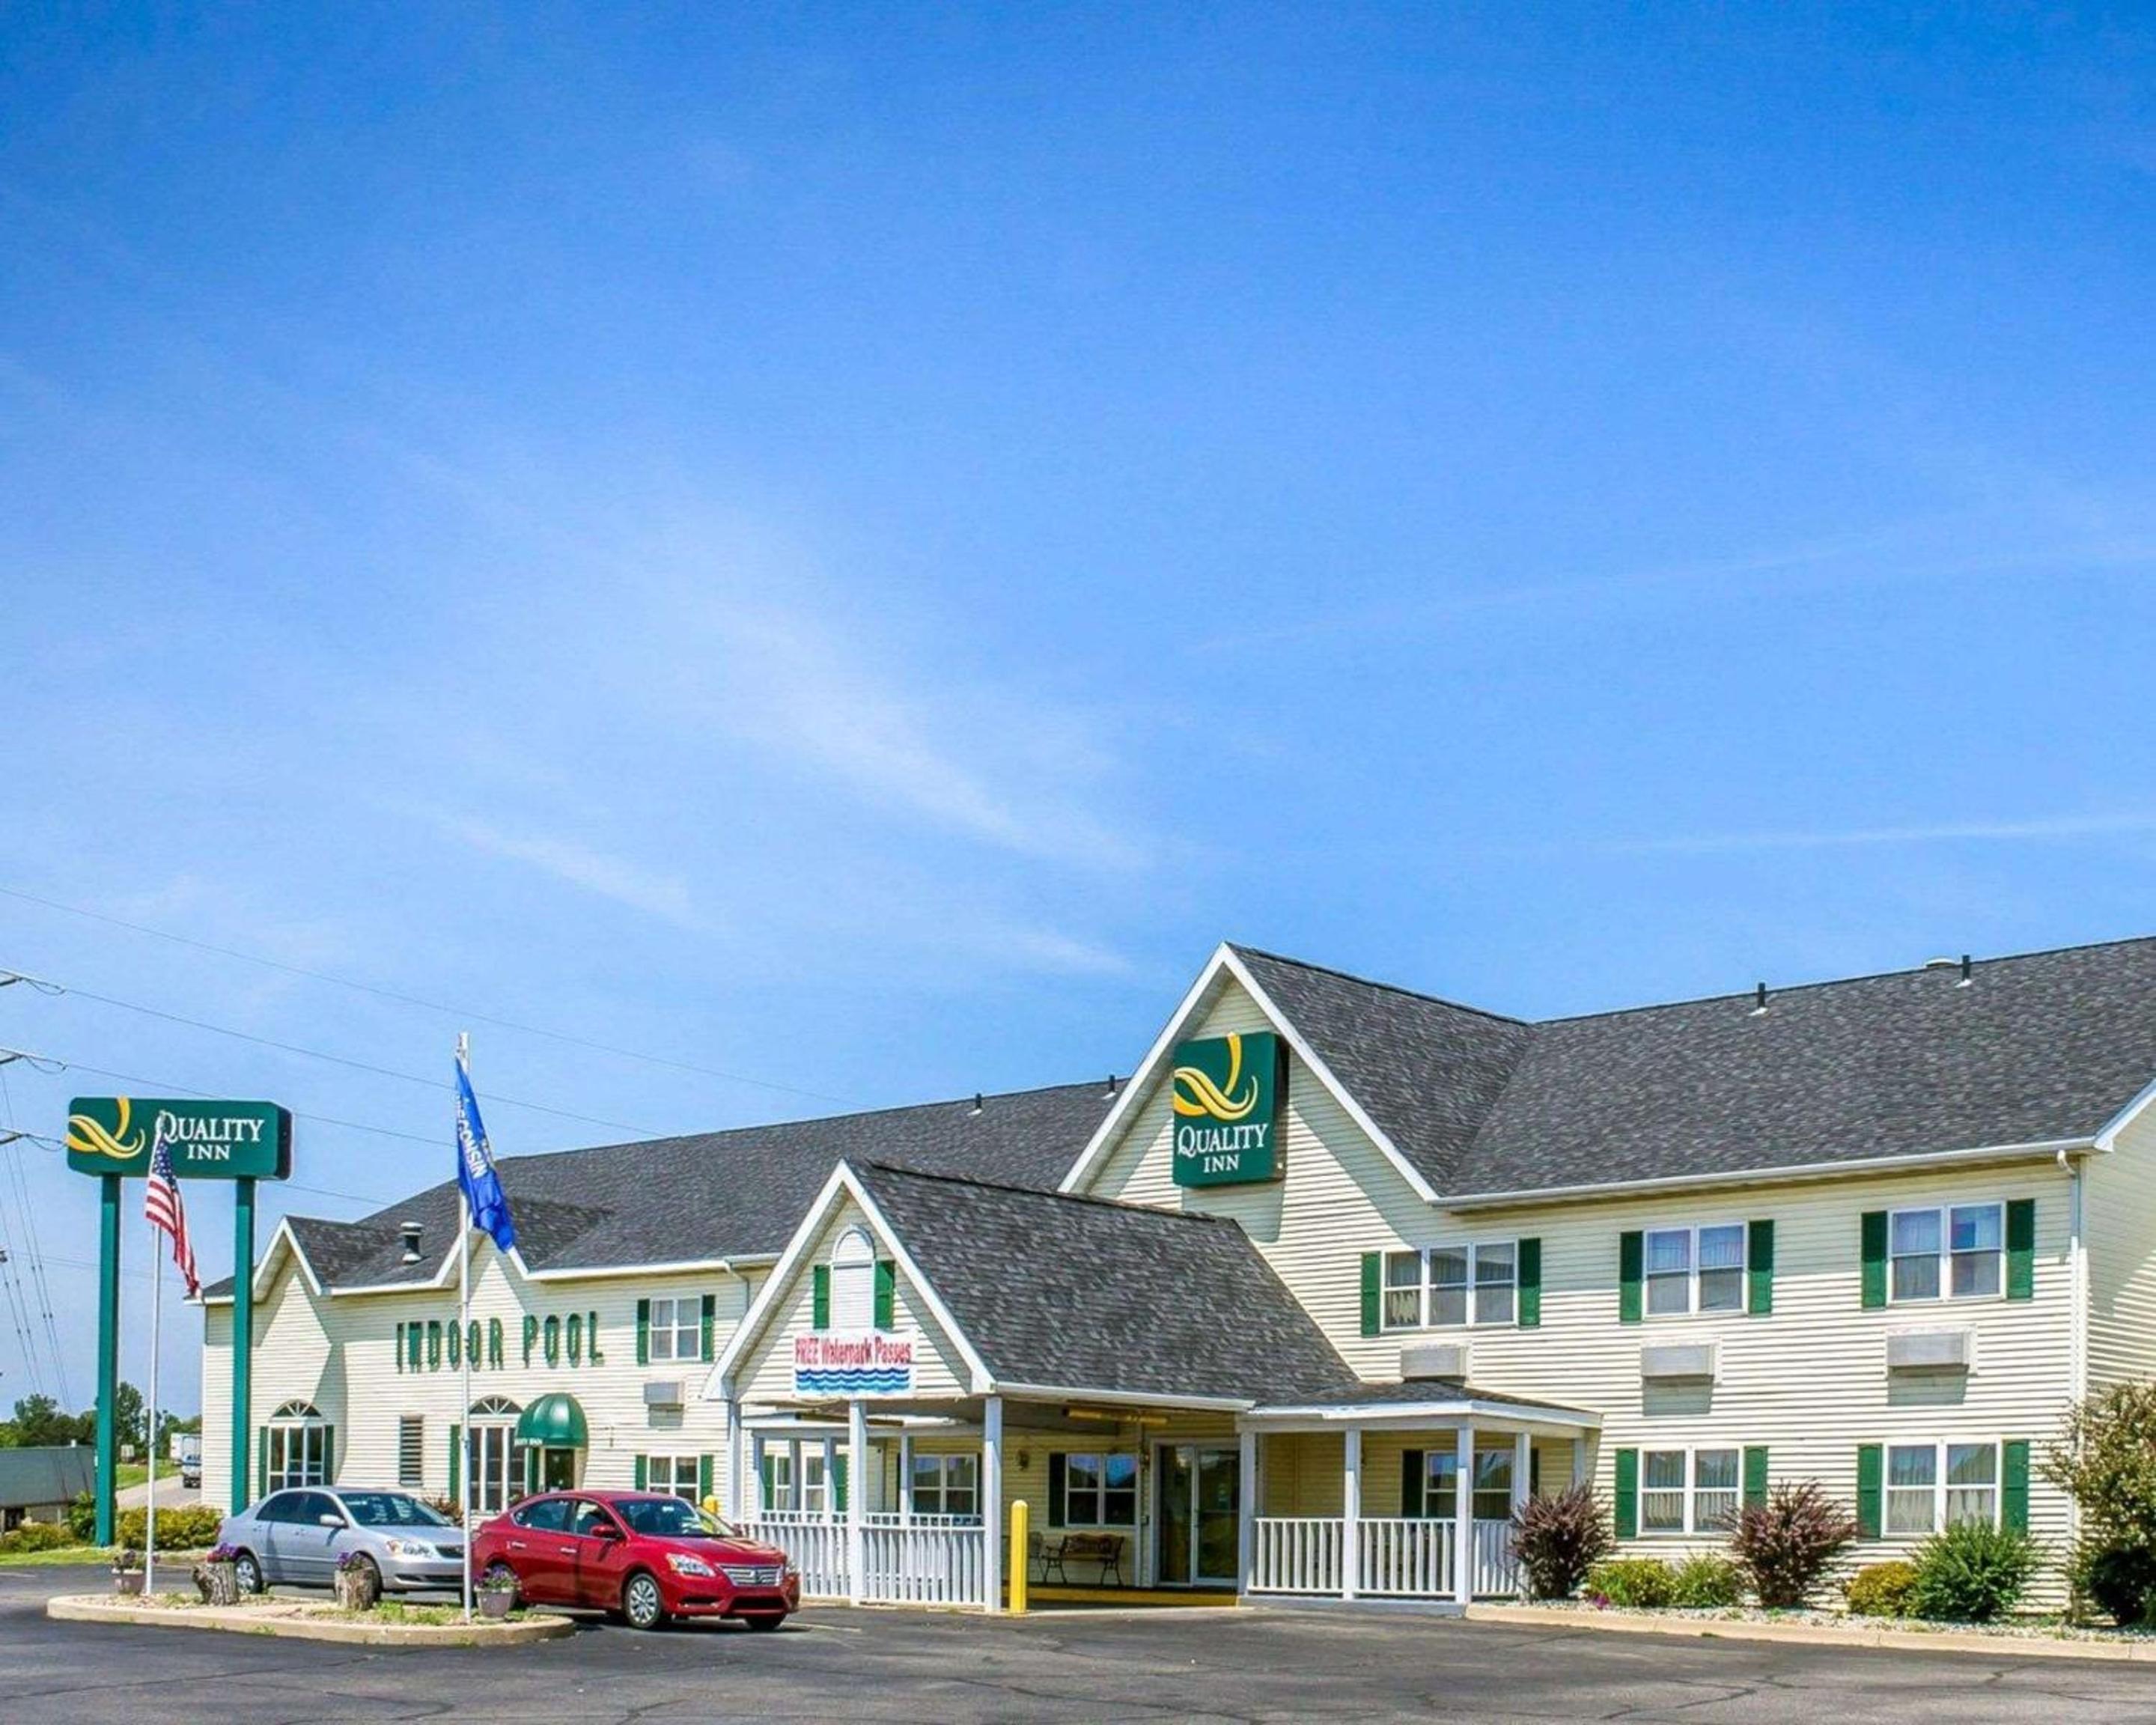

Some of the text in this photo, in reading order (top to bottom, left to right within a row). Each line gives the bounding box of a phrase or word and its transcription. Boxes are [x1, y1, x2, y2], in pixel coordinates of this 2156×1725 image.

[155, 1112, 265, 1143] QUALITY
[455, 1095, 488, 1179] CONSIN
[1178, 1123, 1268, 1158] QUALITY
[187, 1144, 231, 1160] INN
[1203, 1154, 1240, 1173] INN
[396, 1310, 605, 1375] INDOOR POOL
